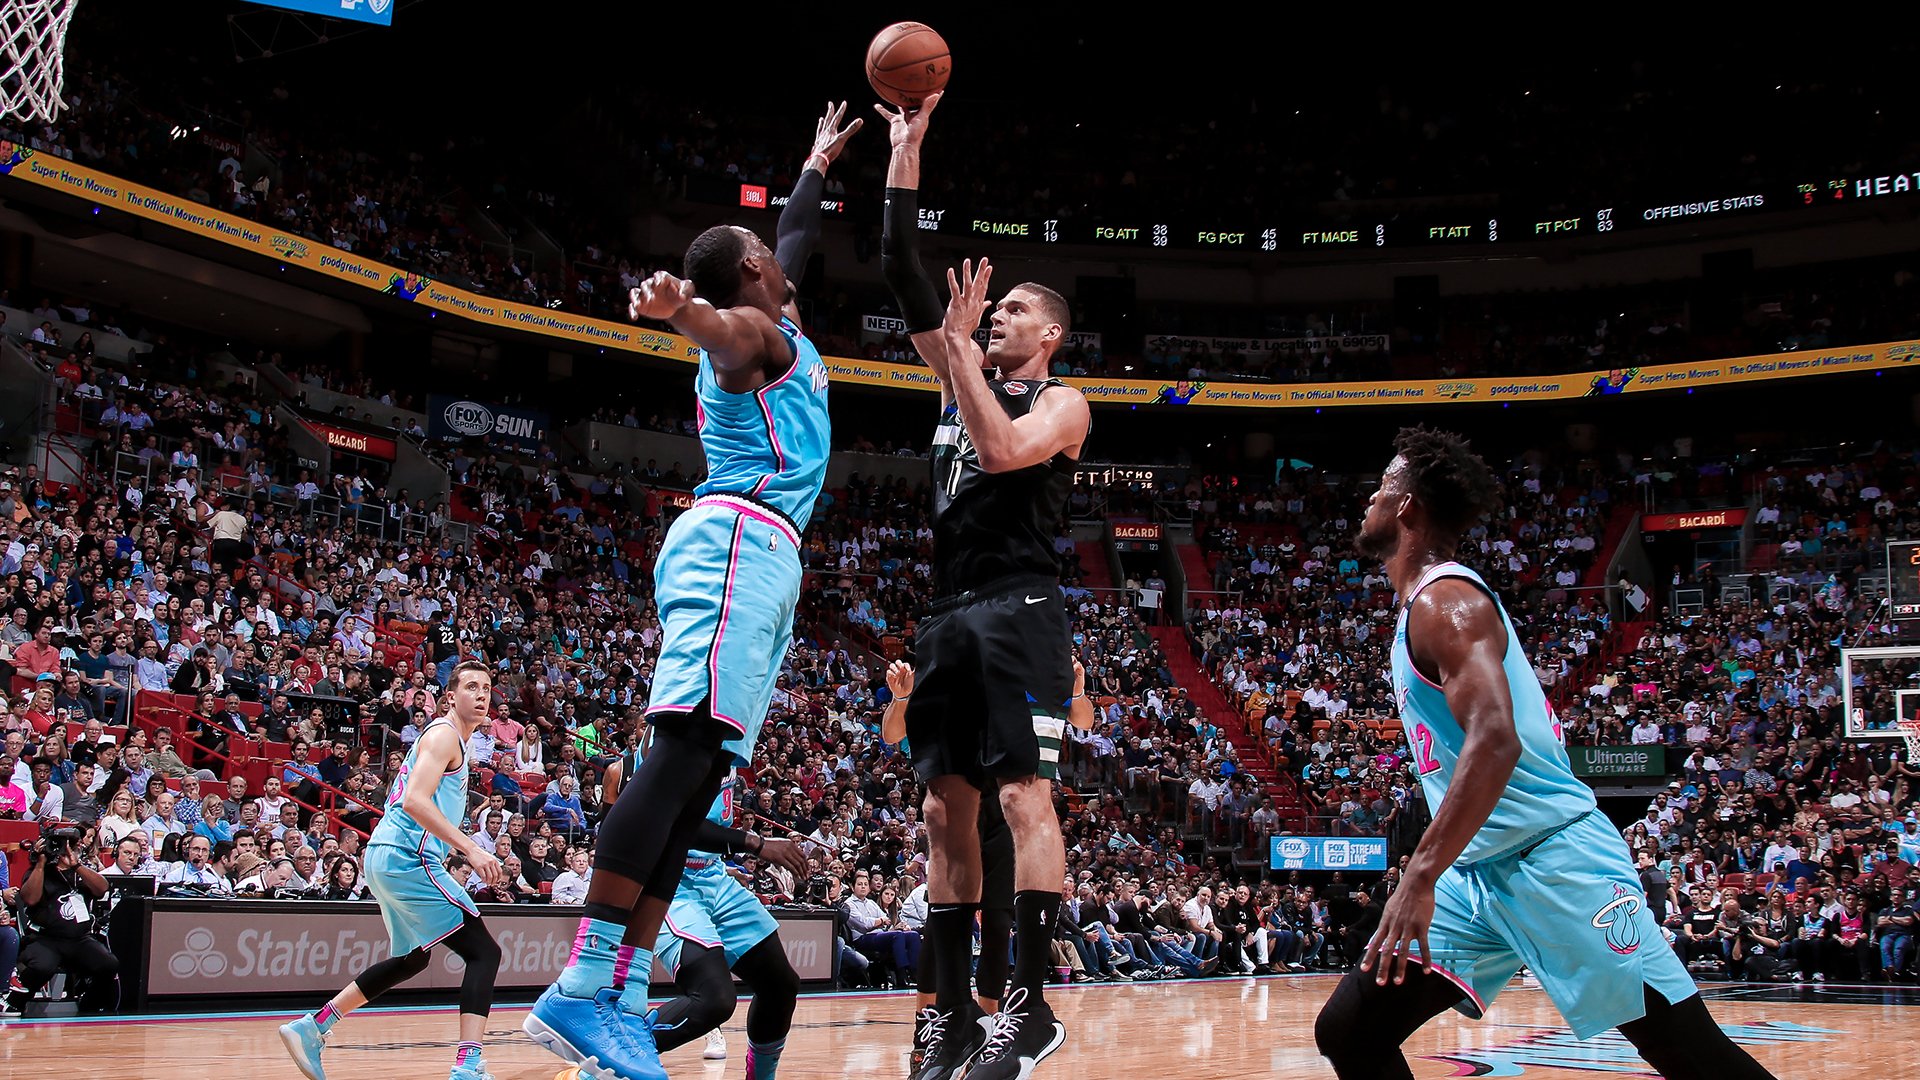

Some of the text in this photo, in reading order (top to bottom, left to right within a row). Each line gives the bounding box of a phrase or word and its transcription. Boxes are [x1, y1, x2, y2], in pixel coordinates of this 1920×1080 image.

[31, 161, 118, 198] Super Hero Movers
[1829, 179, 1847, 189] FLS
[1797, 183, 1817, 193] TOL
[1834, 189, 1843, 200] 4
[745, 190, 763, 203] JBL
[1804, 192, 1813, 204] 5
[1597, 207, 1613, 221] 67
[1644, 194, 1764, 221] OFFENSIVE STATS
[127, 192, 262, 244] The Official Movers of Miami Heat
[918, 208, 945, 222] EAT
[972, 220, 1029, 236] FG MADE
[1043, 219, 1058, 231] 17
[1153, 224, 1168, 236] 38
[1375, 224, 1384, 235] 6
[1488, 218, 1497, 230] 9
[1535, 217, 1580, 234] FT PCT
[1597, 219, 1614, 233] 63
[1043, 231, 1058, 242] 19
[1096, 227, 1139, 240] FG ATT
[1198, 231, 1245, 245] FG PCT
[1261, 228, 1276, 240] 45
[1303, 230, 1358, 244] FT MADE
[1429, 225, 1471, 239] FT ATT
[1488, 230, 1497, 242] 8
[1153, 235, 1168, 247] 39
[1261, 239, 1276, 251] 49
[1376, 235, 1384, 247] 5
[319, 255, 380, 281] goodgreek.com
[429, 289, 494, 316] Super Hero Movers
[503, 309, 517, 321] The
[519, 312, 546, 326] Official
[548, 318, 576, 332] Movers
[577, 323, 586, 334] of
[586, 326, 611, 339] Miami
[612, 330, 629, 342] Heat
[867, 317, 905, 331] NEED
[1212, 338, 1247, 350] Issue
[1251, 339, 1261, 350] &
[1264, 337, 1321, 350] Location
[1325, 337, 1339, 349] to
[1729, 364, 1745, 374] The
[1746, 362, 1776, 374] Official
[1778, 359, 1811, 371] Movers
[1812, 356, 1822, 367] of
[1822, 354, 1851, 366] Miami
[1852, 353, 1874, 363] Heat
[831, 364, 882, 379] Hero Movers
[890, 371, 905, 381] The
[905, 372, 932, 384] Official
[1640, 368, 1720, 385] Super Hero Movers
[1081, 384, 1147, 396] goodgreek.com
[1205, 389, 1282, 402] Super Hero Movers
[1290, 391, 1304, 400] The
[1306, 389, 1334, 400] Official
[1336, 388, 1366, 399] Movers
[1367, 387, 1376, 398] of
[1377, 387, 1404, 398] Miami
[1405, 387, 1424, 397] Heat
[1490, 382, 1560, 396] goodgreek.com
[455, 406, 484, 425] FOX
[495, 414, 534, 438] SUN
[328, 432, 367, 452] BACARDÍ
[1680, 511, 1726, 528] BACARDÍ
[1115, 525, 1159, 538] BACARDÍ
[441, 631, 455, 644] 22
[1585, 749, 1648, 764] Ultimate
[1588, 764, 1646, 773] SOFTWARE
[1284, 842, 1302, 851] FOX
[1328, 843, 1345, 852] FOX
[1350, 843, 1382, 855] STREAM
[1328, 854, 1345, 864] GO
[1350, 854, 1368, 865] LIVE
